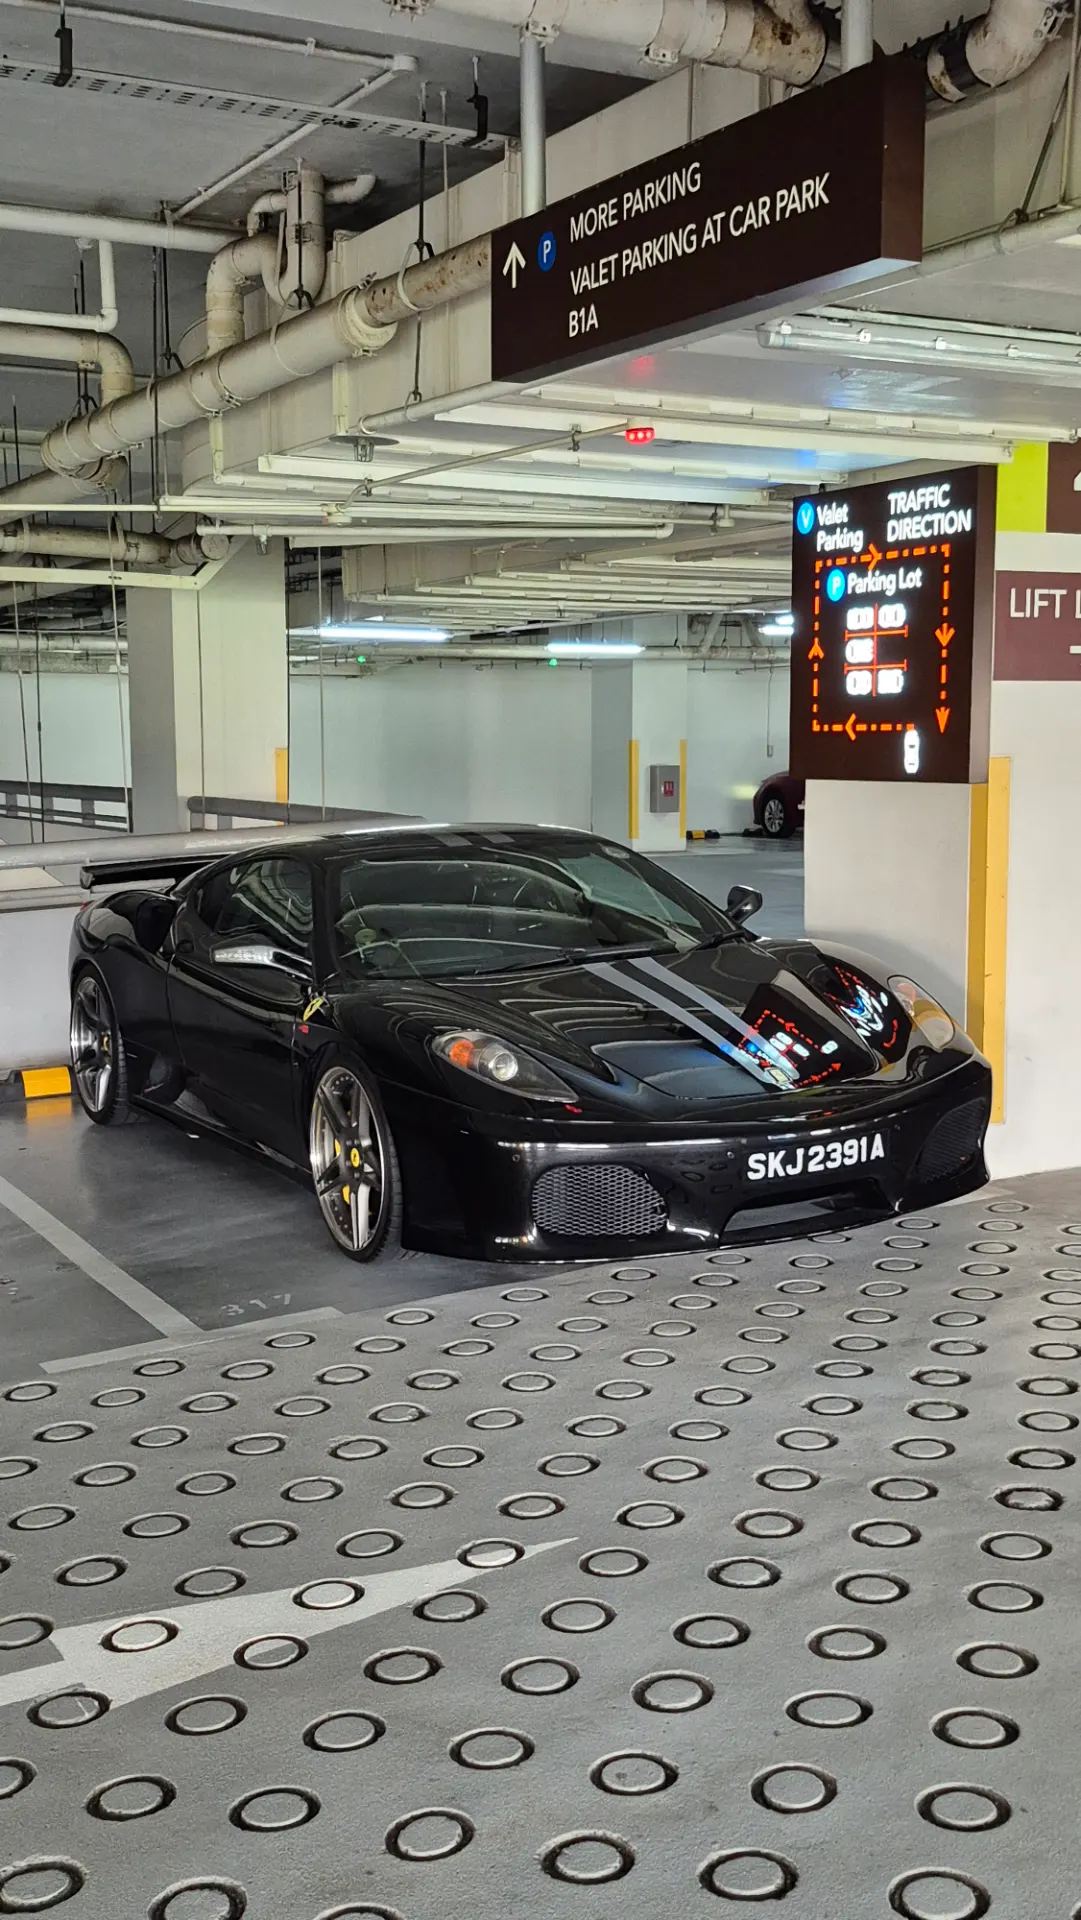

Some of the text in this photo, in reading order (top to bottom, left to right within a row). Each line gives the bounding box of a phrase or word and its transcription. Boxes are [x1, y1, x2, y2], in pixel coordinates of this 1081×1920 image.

[570, 161, 702, 243] MORE PARKING
[570, 172, 830, 295] VALET PARKING AT CAR PARK
[543, 239, 552, 263] P
[569, 303, 598, 337] B1A
[887, 484, 951, 515] TRAFFIC
[816, 503, 849, 527] Valet
[886, 509, 972, 542] DIRECTION
[816, 528, 864, 553] Parking
[847, 568, 923, 596] Parking Lot
[1010, 588, 1067, 618] LIFT
[221, 1293, 291, 1315] 317
